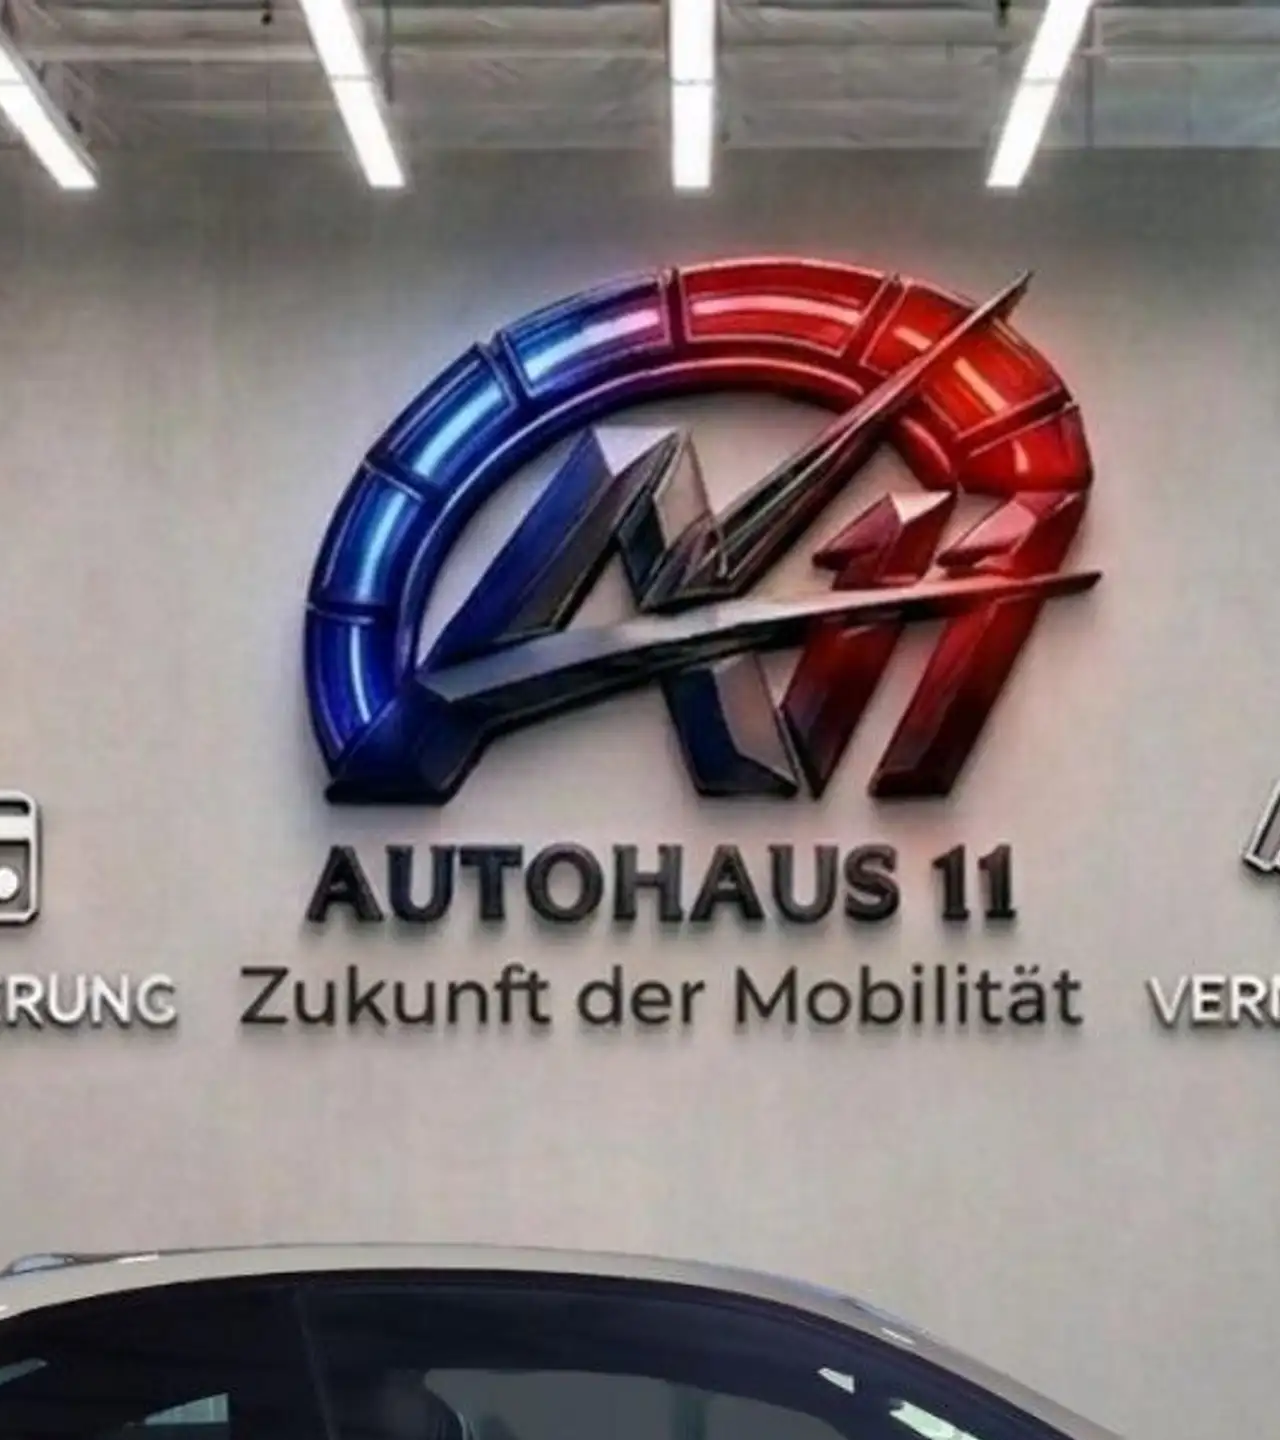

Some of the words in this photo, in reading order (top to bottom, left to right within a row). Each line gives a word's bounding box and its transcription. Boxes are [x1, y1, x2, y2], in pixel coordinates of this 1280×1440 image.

[306, 845, 902, 923] AUTOHAUS
[931, 845, 1018, 922] 11
[240, 965, 552, 1026] Zukunft
[577, 965, 706, 1027] der
[733, 965, 1083, 1027] Mobilität
